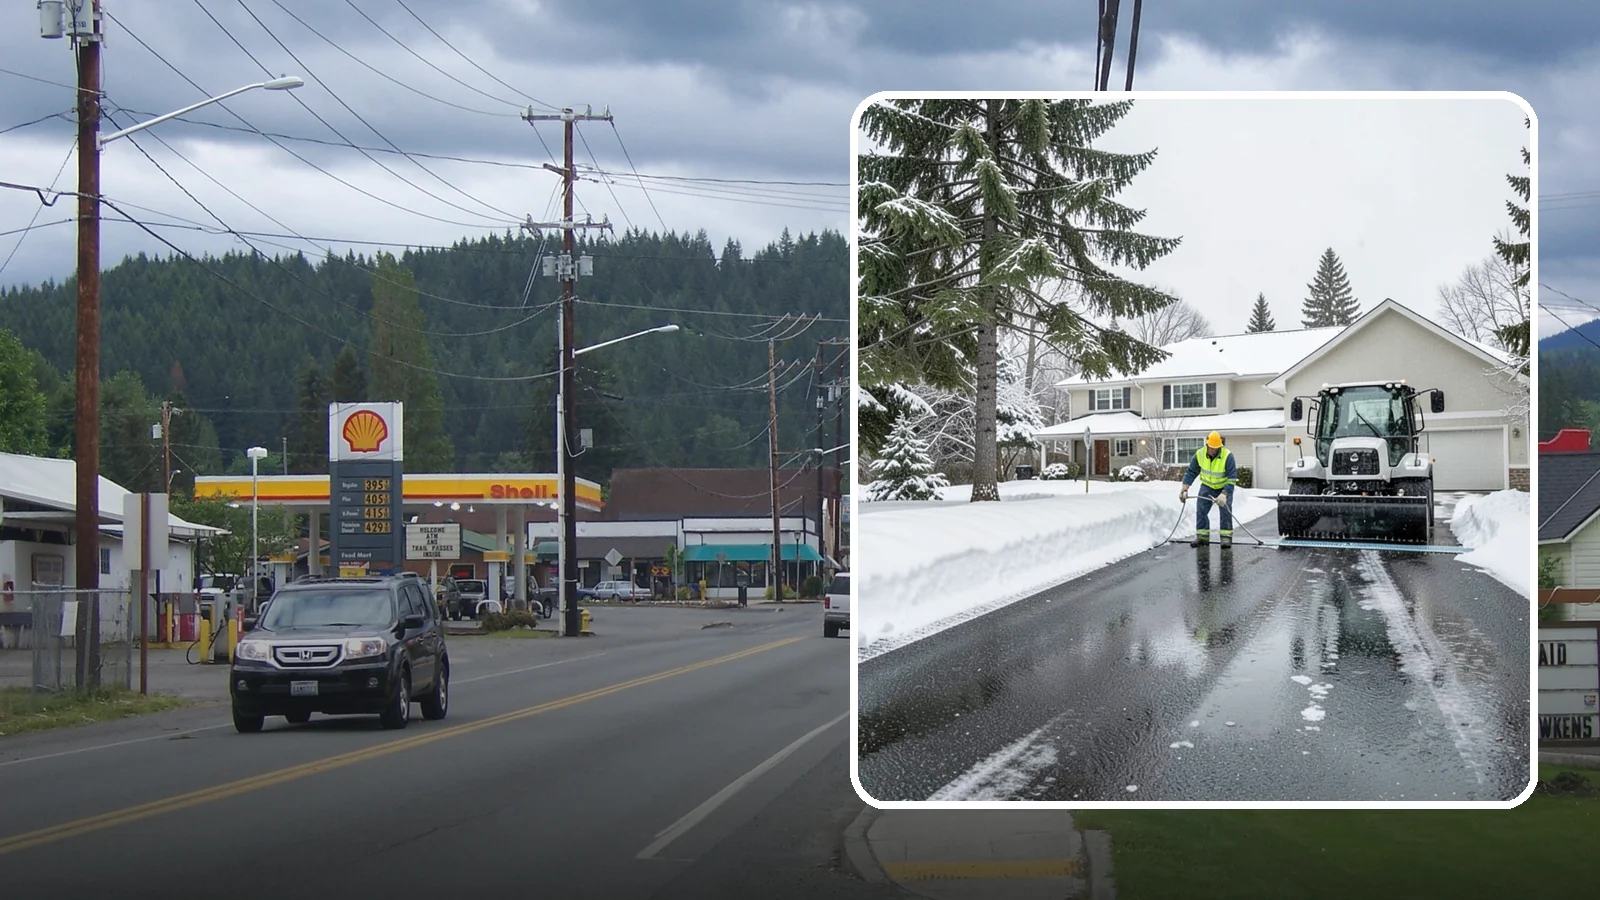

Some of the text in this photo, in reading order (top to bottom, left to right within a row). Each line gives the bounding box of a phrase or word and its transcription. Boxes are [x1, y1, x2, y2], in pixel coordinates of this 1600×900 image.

[366, 480, 383, 490] 395
[490, 484, 547, 499] Shell
[366, 494, 383, 504] 405
[366, 508, 383, 518] 415
[366, 522, 384, 532] 429
